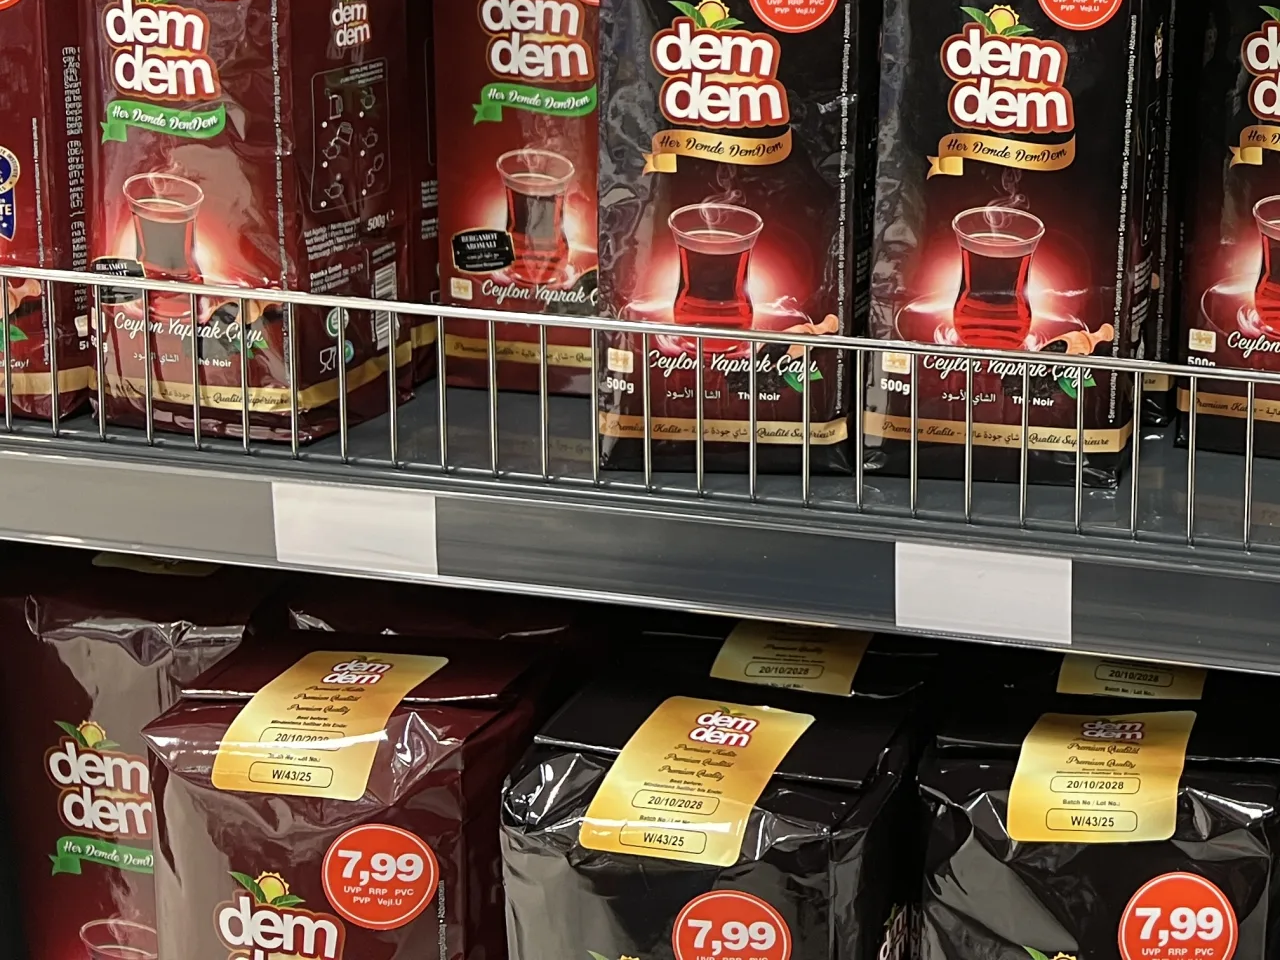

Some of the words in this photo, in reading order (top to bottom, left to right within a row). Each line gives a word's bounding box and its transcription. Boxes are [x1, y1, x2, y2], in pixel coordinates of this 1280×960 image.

[656, 22, 775, 77] dem
[945, 28, 1063, 84] dem
[114, 45, 216, 96] dem
[665, 72, 784, 122] dem
[952, 77, 1069, 129] dem
[112, 104, 130, 120] Her
[481, 278, 531, 305] Ceylon
[534, 283, 586, 305] Yaprak
[606, 376, 635, 394] 500g
[759, 392, 781, 401] Noir
[697, 711, 757, 732] dem
[689, 726, 750, 747] dem
[48, 741, 149, 796] dem
[271, 768, 313, 783] W/43/25
[1066, 780, 1124, 790] 20/10/2028
[648, 795, 703, 810] 20/10/2028
[1070, 815, 1115, 827] W/43/25
[643, 832, 685, 847] W/43/25
[336, 848, 425, 888] 7,99
[686, 919, 777, 957] 7,99
[1135, 906, 1224, 947] 7,99
